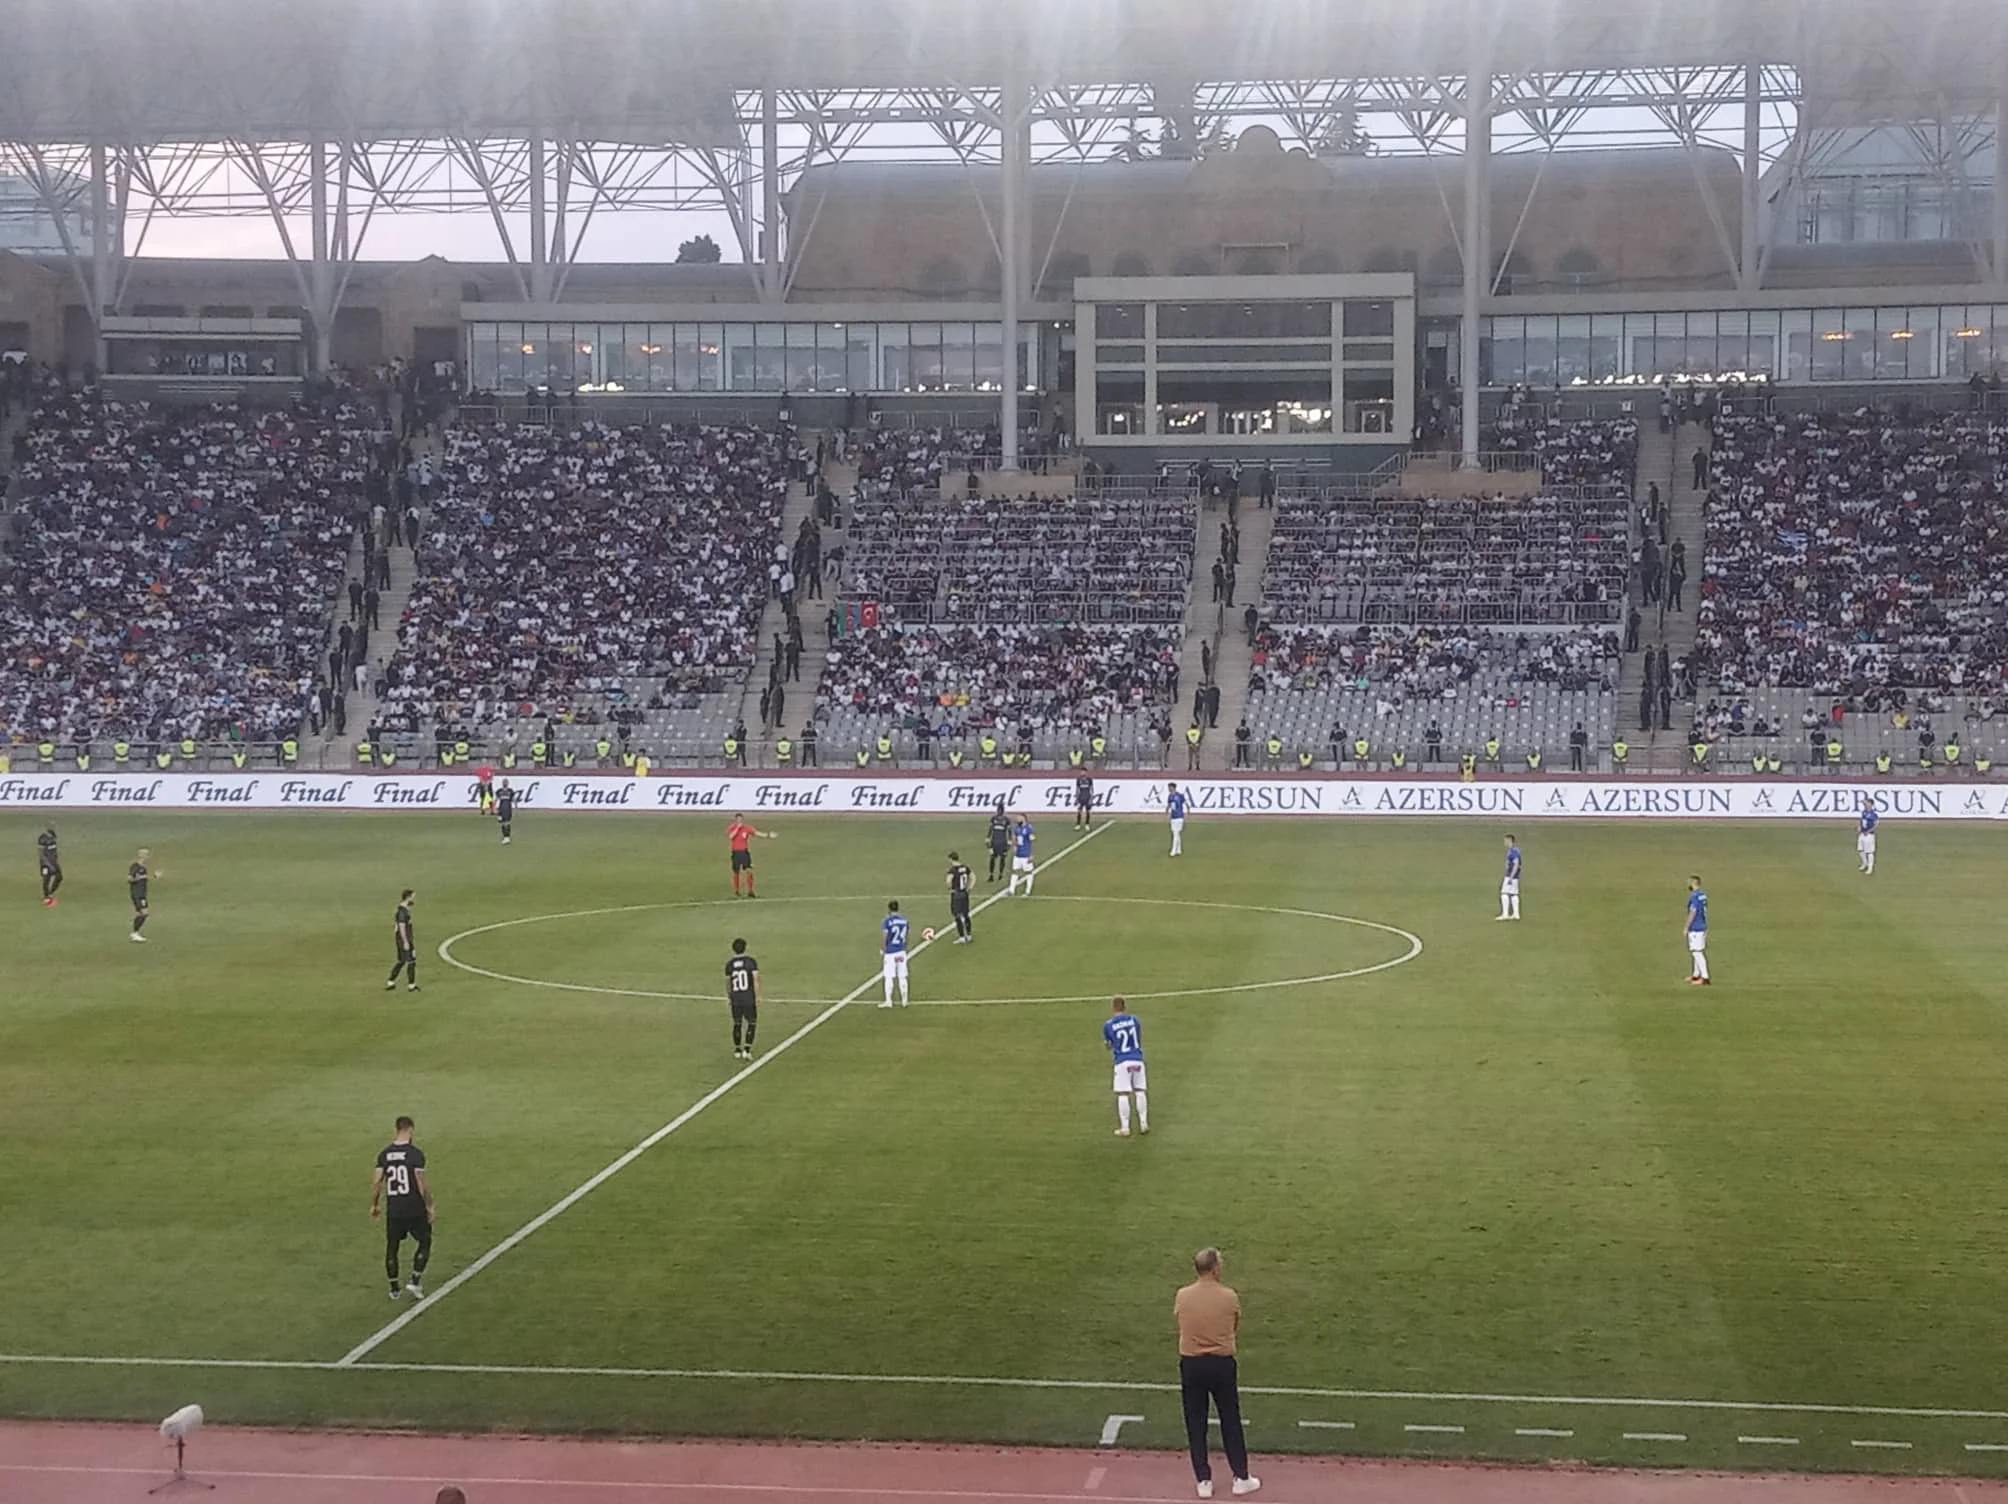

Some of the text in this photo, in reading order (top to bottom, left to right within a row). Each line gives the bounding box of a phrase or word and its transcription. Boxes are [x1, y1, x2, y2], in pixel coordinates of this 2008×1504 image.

[0, 779, 1120, 807] Final Final Final Final Final Fal Final Final Final Final Final Fial
[1185, 786, 1323, 810] AZERSUN
[1374, 787, 1524, 811] AZERSUN
[1580, 788, 1732, 813] AZERSUN
[1787, 789, 1942, 813] AZERSUN
[731, 969, 749, 992] 20
[1116, 1026, 1140, 1053] 21
[386, 1164, 410, 1196] 29
